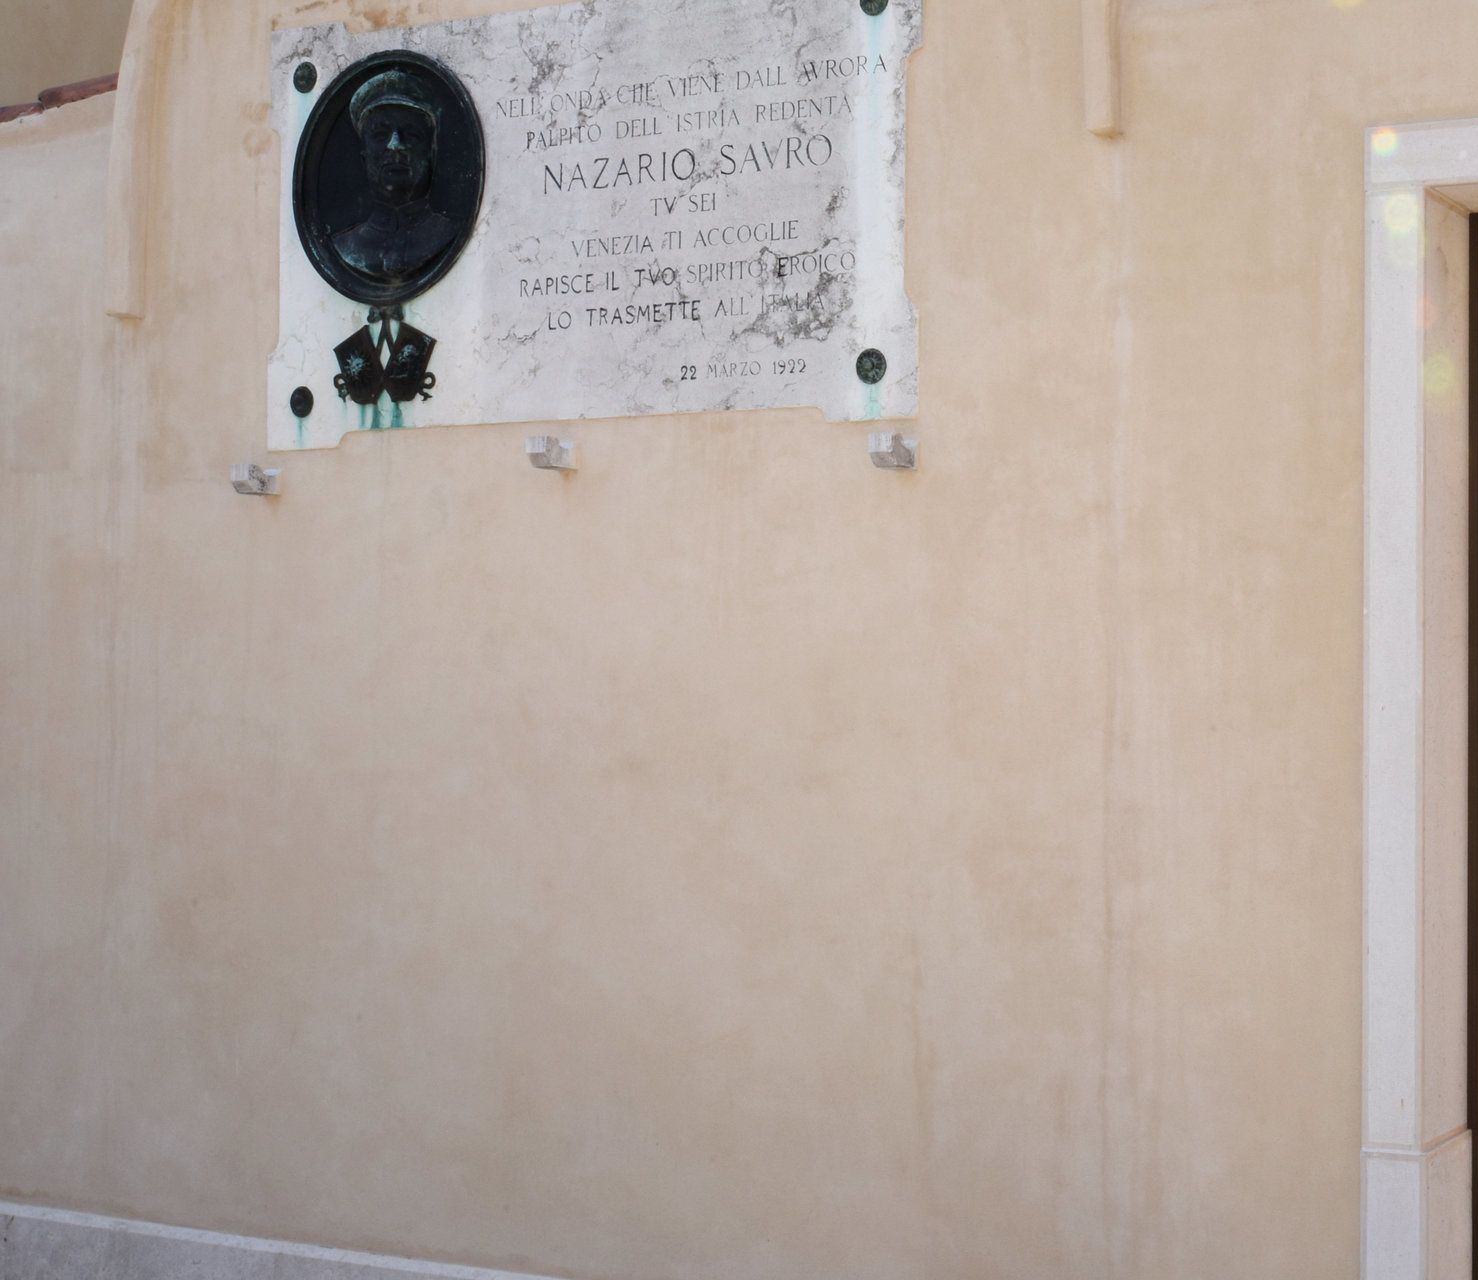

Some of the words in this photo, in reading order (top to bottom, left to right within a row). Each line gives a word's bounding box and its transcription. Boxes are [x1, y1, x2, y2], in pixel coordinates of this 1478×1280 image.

[668, 73, 725, 100] VIENE
[526, 124, 602, 150] PALPITO
[755, 94, 852, 122] REDENTA
[543, 148, 696, 194] NAZARIO
[720, 134, 832, 176] SAVRO
[688, 192, 716, 213] SEI
[572, 235, 654, 258] VENEZIA
[664, 230, 682, 250] TI
[693, 219, 799, 248] ACCOGLIE
[519, 273, 594, 297] RAPISCE
[606, 271, 620, 291] IL
[687, 259, 764, 284] SPIRITO
[778, 251, 856, 278] EROICO
[548, 311, 572, 331] LO
[586, 300, 701, 326] TRASMETTE
[681, 365, 697, 381] 22
[707, 360, 762, 379] MARZO
